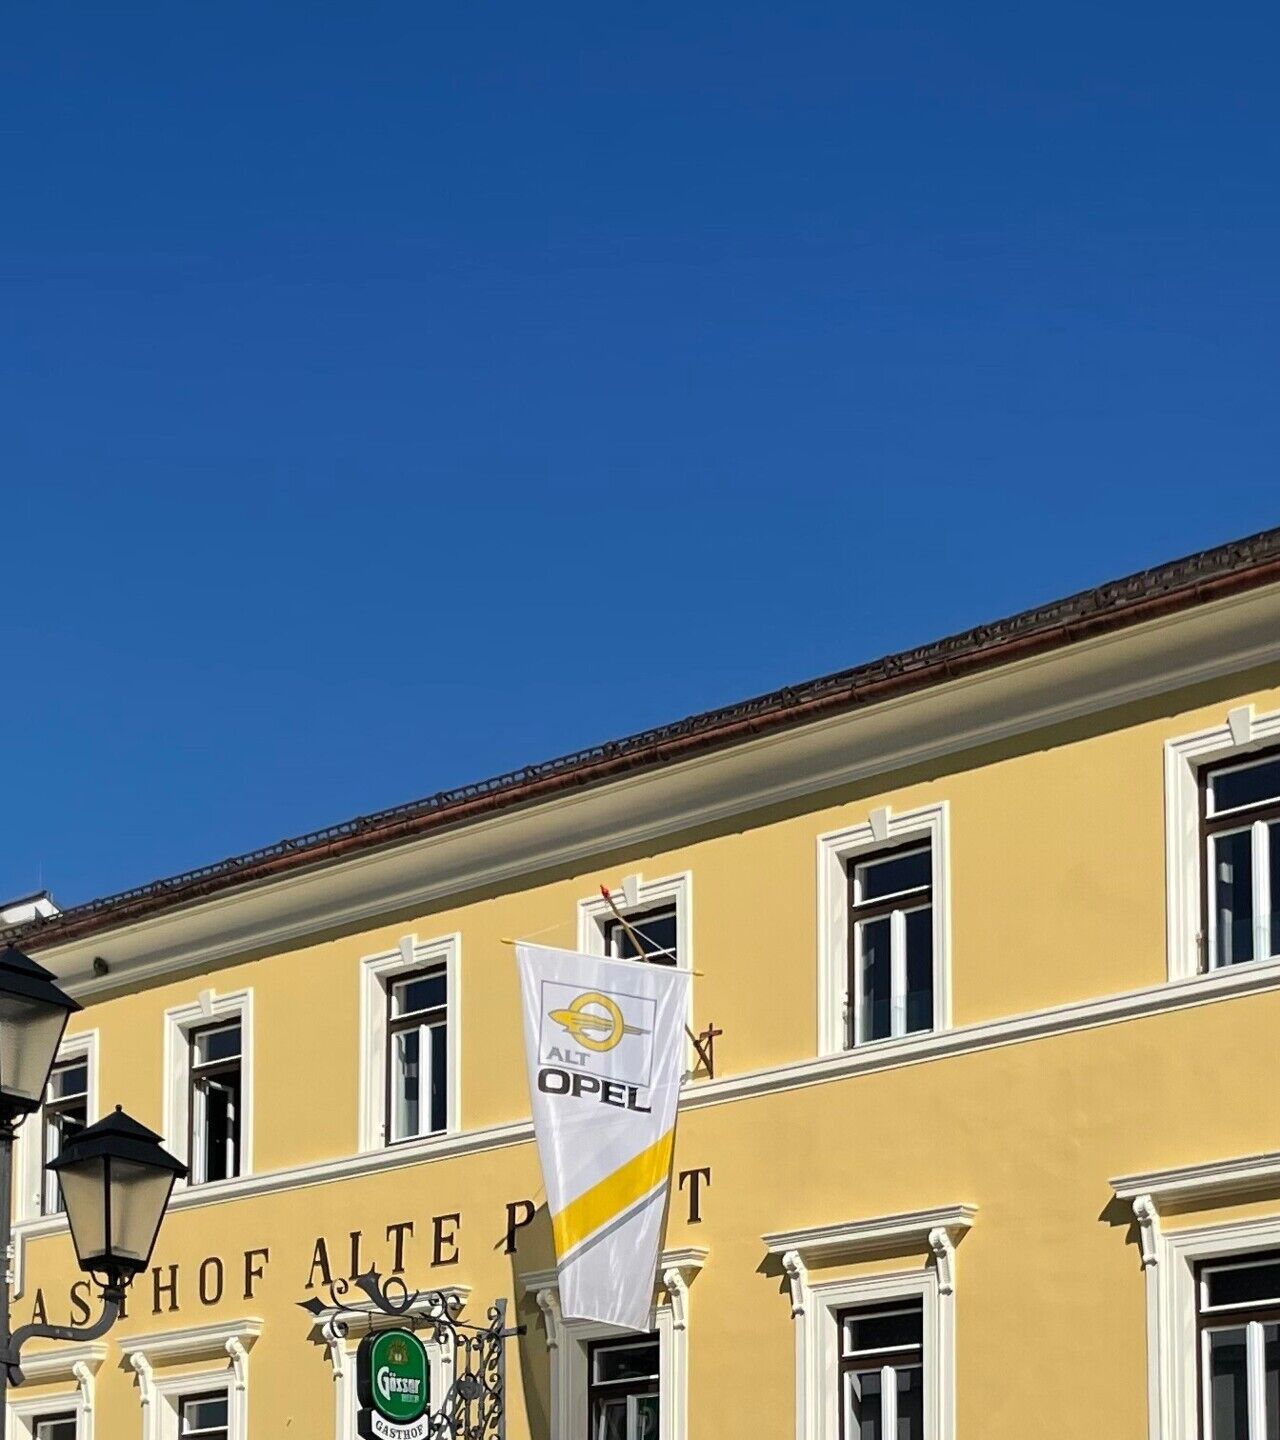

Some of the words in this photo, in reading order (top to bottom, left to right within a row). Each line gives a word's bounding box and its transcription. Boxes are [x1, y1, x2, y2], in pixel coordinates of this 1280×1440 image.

[546, 1046, 591, 1067] ALT
[538, 1068, 652, 1114] OPEL
[304, 1211, 461, 1290] ALTE
[504, 1166, 712, 1256] PT
[377, 1366, 421, 1401] Gösser
[375, 1420, 424, 1440] GASTHOF
